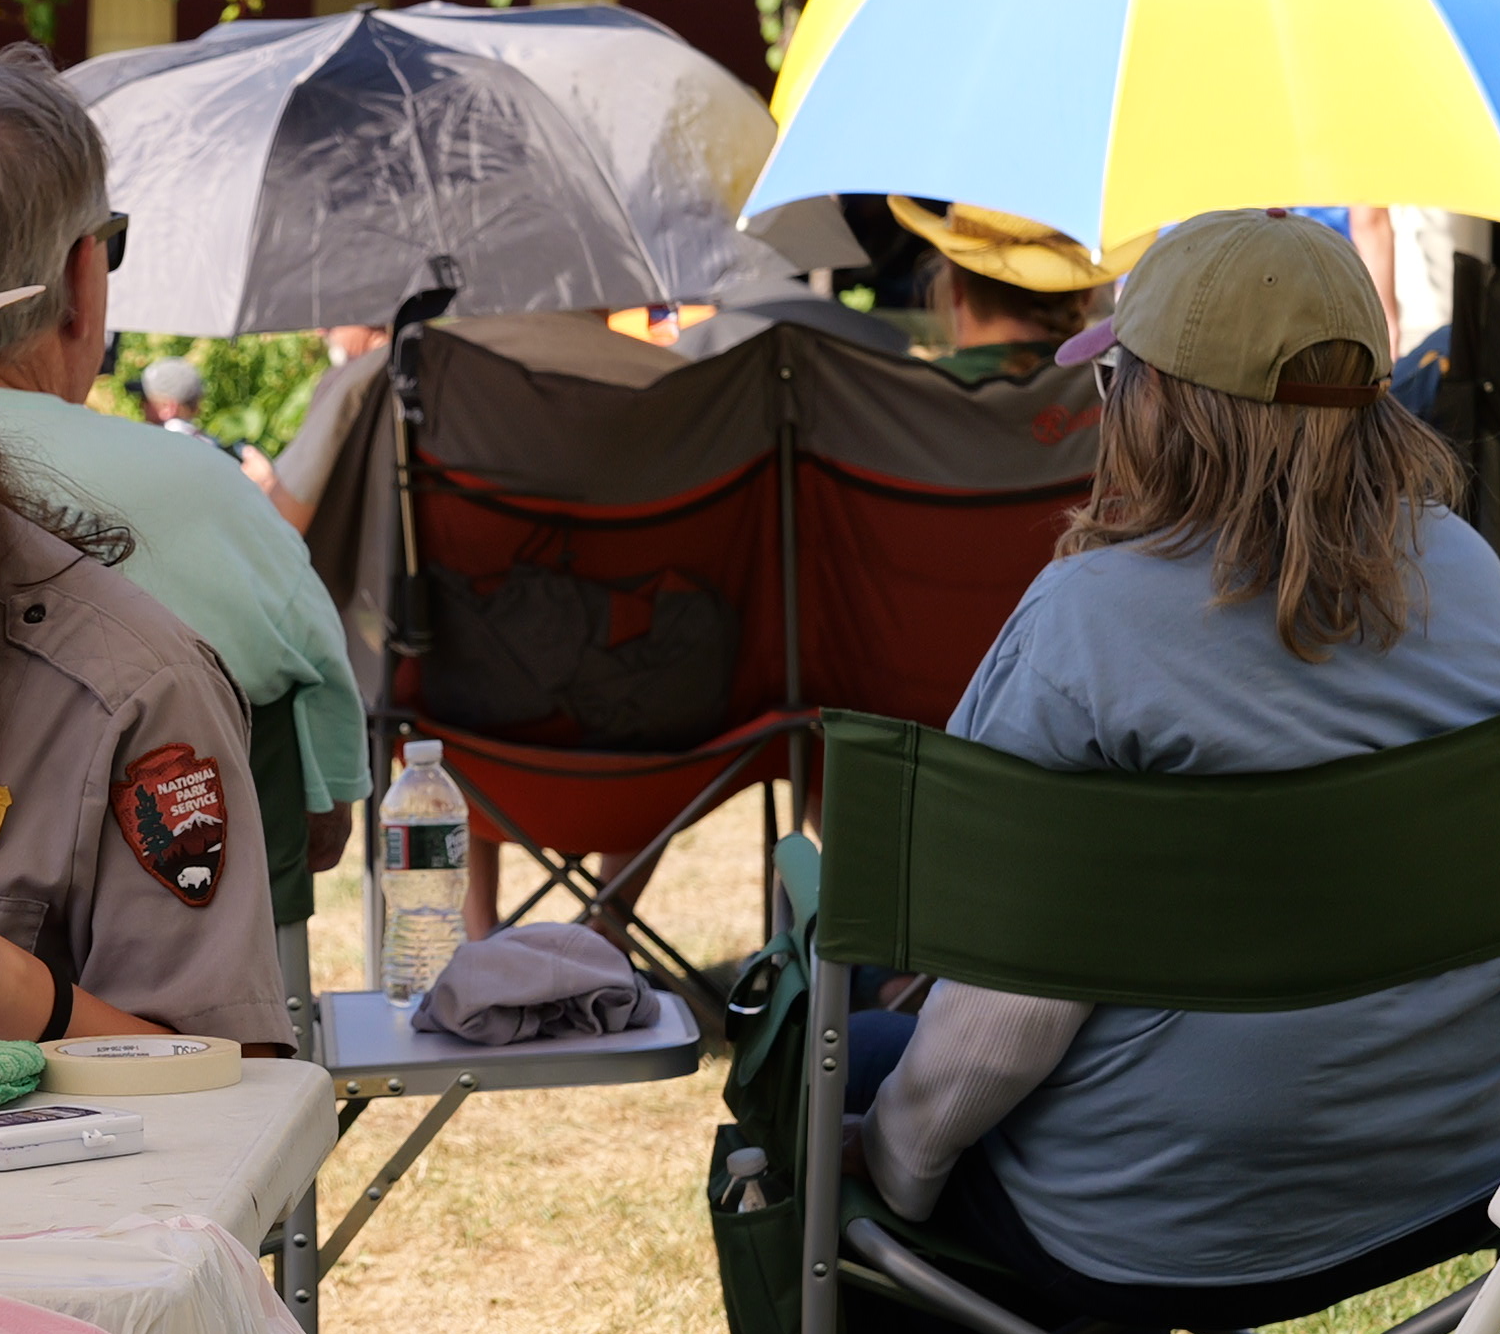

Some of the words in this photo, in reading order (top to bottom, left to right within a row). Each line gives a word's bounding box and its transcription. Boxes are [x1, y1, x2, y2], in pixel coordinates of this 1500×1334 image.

[157, 768, 216, 795] NATIONAL
[176, 783, 208, 803] PARK
[170, 792, 218, 817] SERVICE
